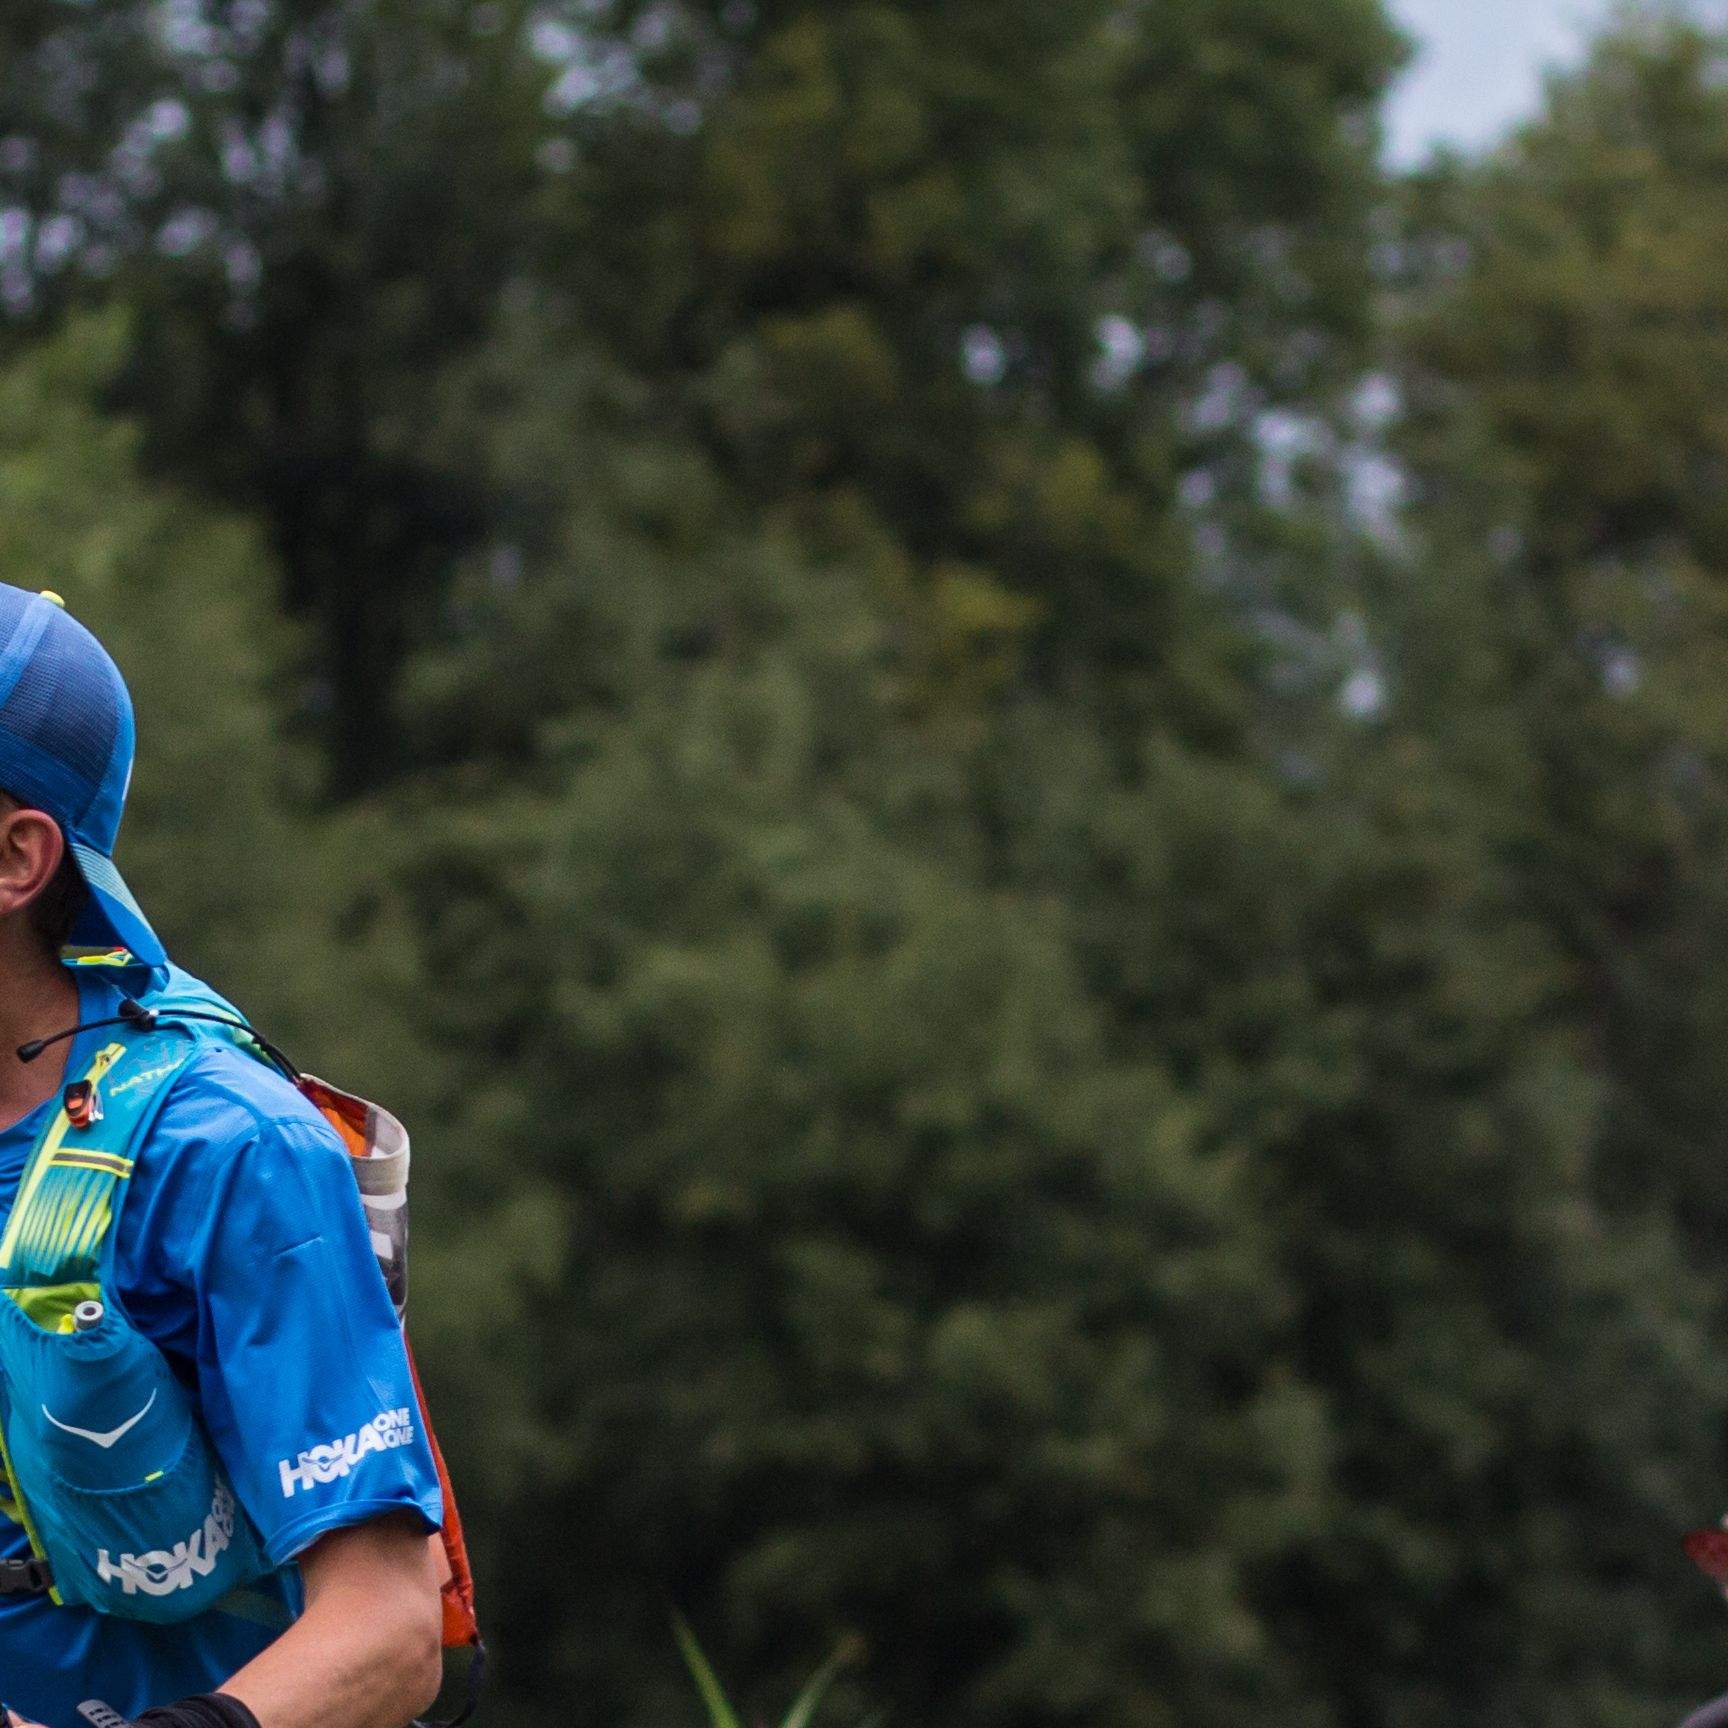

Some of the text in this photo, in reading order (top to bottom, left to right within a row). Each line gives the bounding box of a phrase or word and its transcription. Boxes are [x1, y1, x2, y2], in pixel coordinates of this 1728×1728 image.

[278, 1422, 387, 1499] HOKA
[372, 1407, 410, 1432] ONE
[97, 1513, 230, 1597] HOKA
